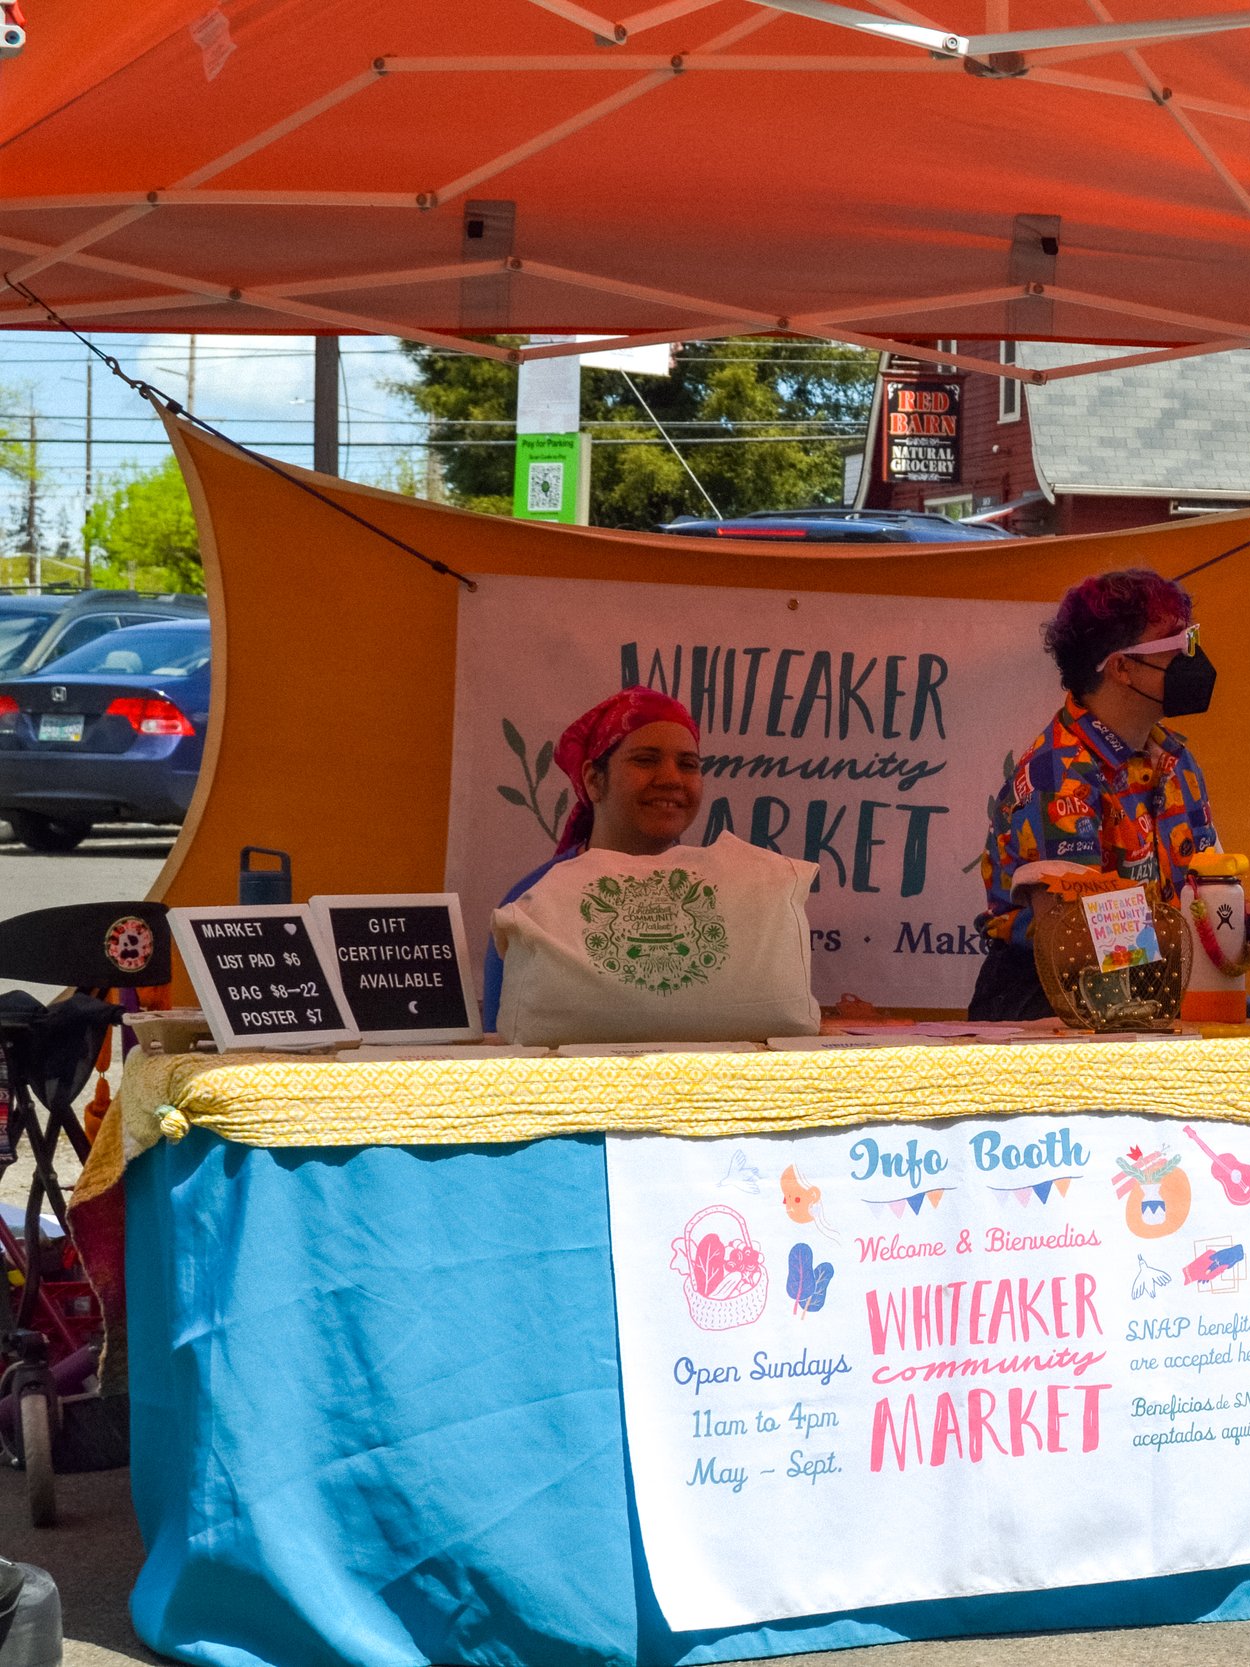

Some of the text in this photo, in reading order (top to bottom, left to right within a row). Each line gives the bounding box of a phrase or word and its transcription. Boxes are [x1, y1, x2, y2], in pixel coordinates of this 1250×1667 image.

[897, 390, 950, 412] RED
[890, 412, 957, 436] BARN
[892, 445, 954, 460] NATURAL
[890, 459, 955, 473] GROCERY
[700, 752, 947, 791] mmunity
[1056, 796, 1089, 816] OAFS
[701, 796, 949, 897] ARKET
[1130, 863, 1153, 881] LAZY
[1087, 894, 1144, 914] WHITEAKER
[368, 918, 406, 933] GIFT
[623, 911, 679, 922] COMMUNITY
[1091, 907, 1146, 925] COMMUNITY
[202, 922, 263, 939] MARKET
[1094, 920, 1140, 941] MARKET
[216, 952, 301, 969] LIST PAD $6
[338, 944, 452, 962] CERTIFICATES
[360, 972, 443, 989] AVAILABLE
[228, 985, 263, 1001] BAG
[241, 1008, 323, 1027] POSTER $7
[849, 1127, 1091, 1189] Info Booth
[855, 1223, 1102, 1263] Welcome & Bienvedios
[866, 1273, 1104, 1355] WHITEAKER
[1125, 1316, 1191, 1341] SNAP
[872, 1347, 1107, 1384] community
[1130, 1357, 1159, 1371] are
[1164, 1343, 1233, 1374] accepted
[673, 1348, 853, 1395] Open Sundays
[1131, 1394, 1215, 1421] Beneficios
[1216, 1394, 1230, 1410] de
[692, 1402, 839, 1439] 11am to 4pm
[870, 1384, 1113, 1473] MARKET
[1133, 1421, 1216, 1453] aceptados
[686, 1457, 748, 1493] May
[787, 1450, 842, 1485] Sept.
